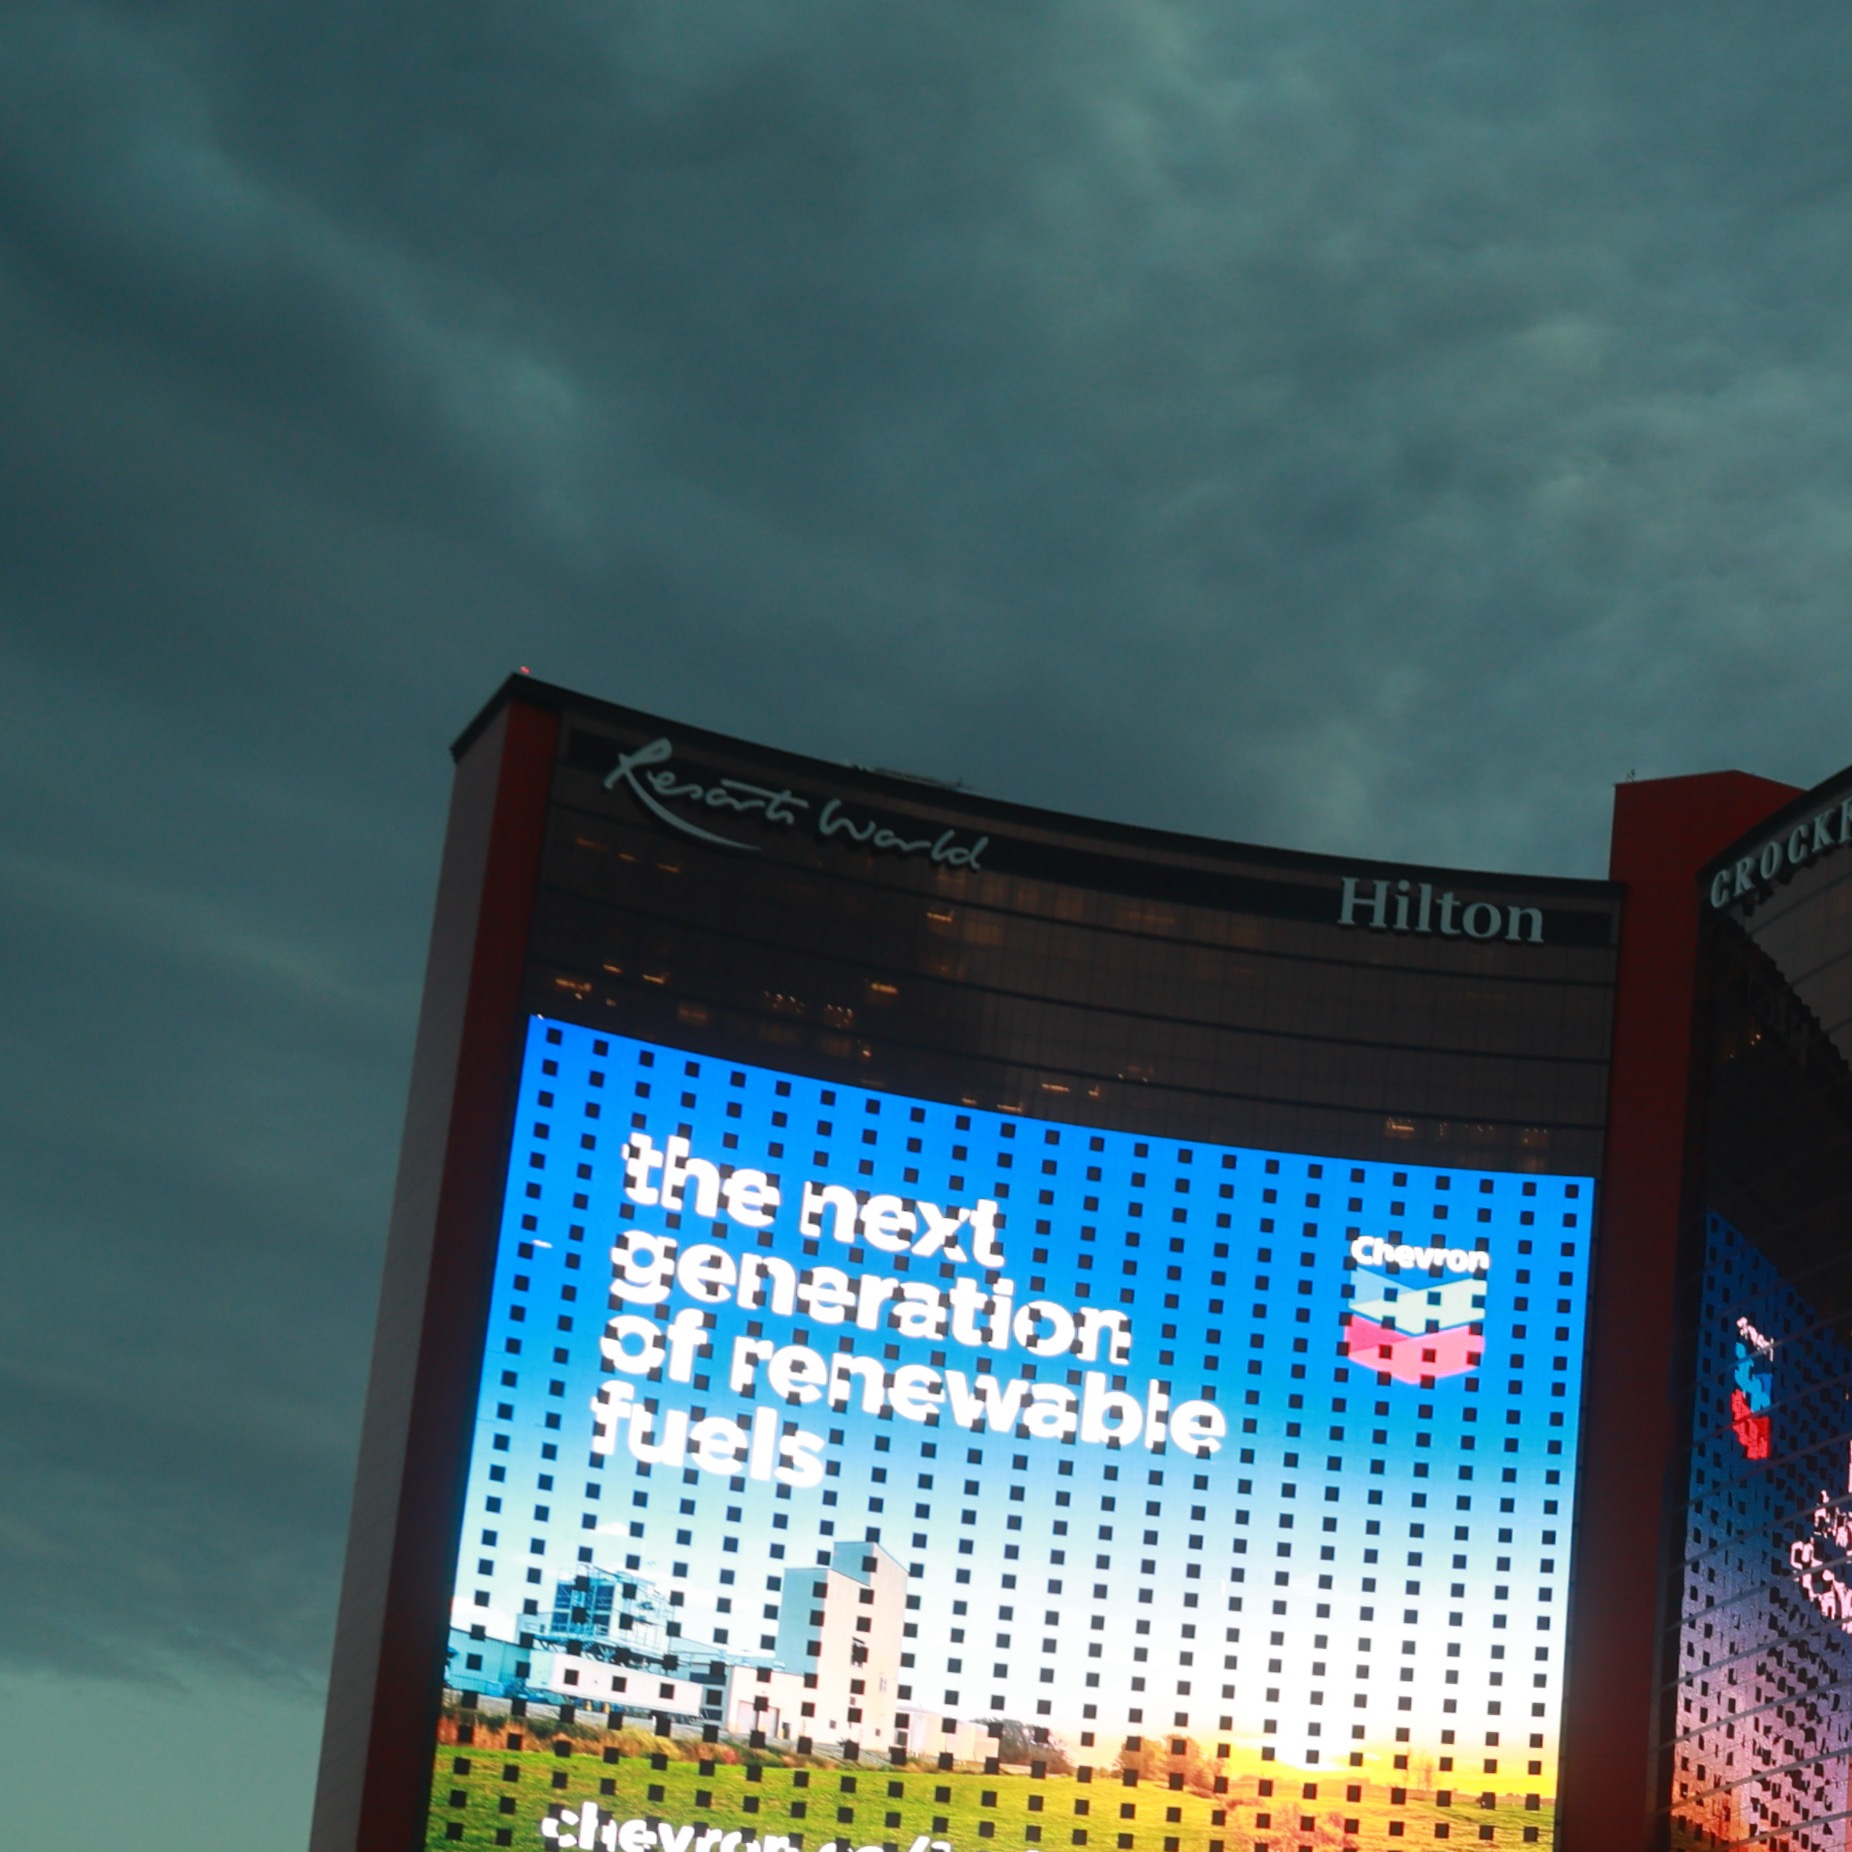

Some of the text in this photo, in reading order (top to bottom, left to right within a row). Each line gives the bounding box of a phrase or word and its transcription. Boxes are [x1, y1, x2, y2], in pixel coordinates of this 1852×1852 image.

[818, 798, 990, 871] World
[1337, 876, 1545, 944] Hilton
[622, 1132, 1007, 1269] the next
[1350, 1235, 1491, 1273] Chevron
[608, 1230, 1133, 1367] generation
[590, 1379, 827, 1490] fuels
[599, 1308, 1228, 1456] of renewable
